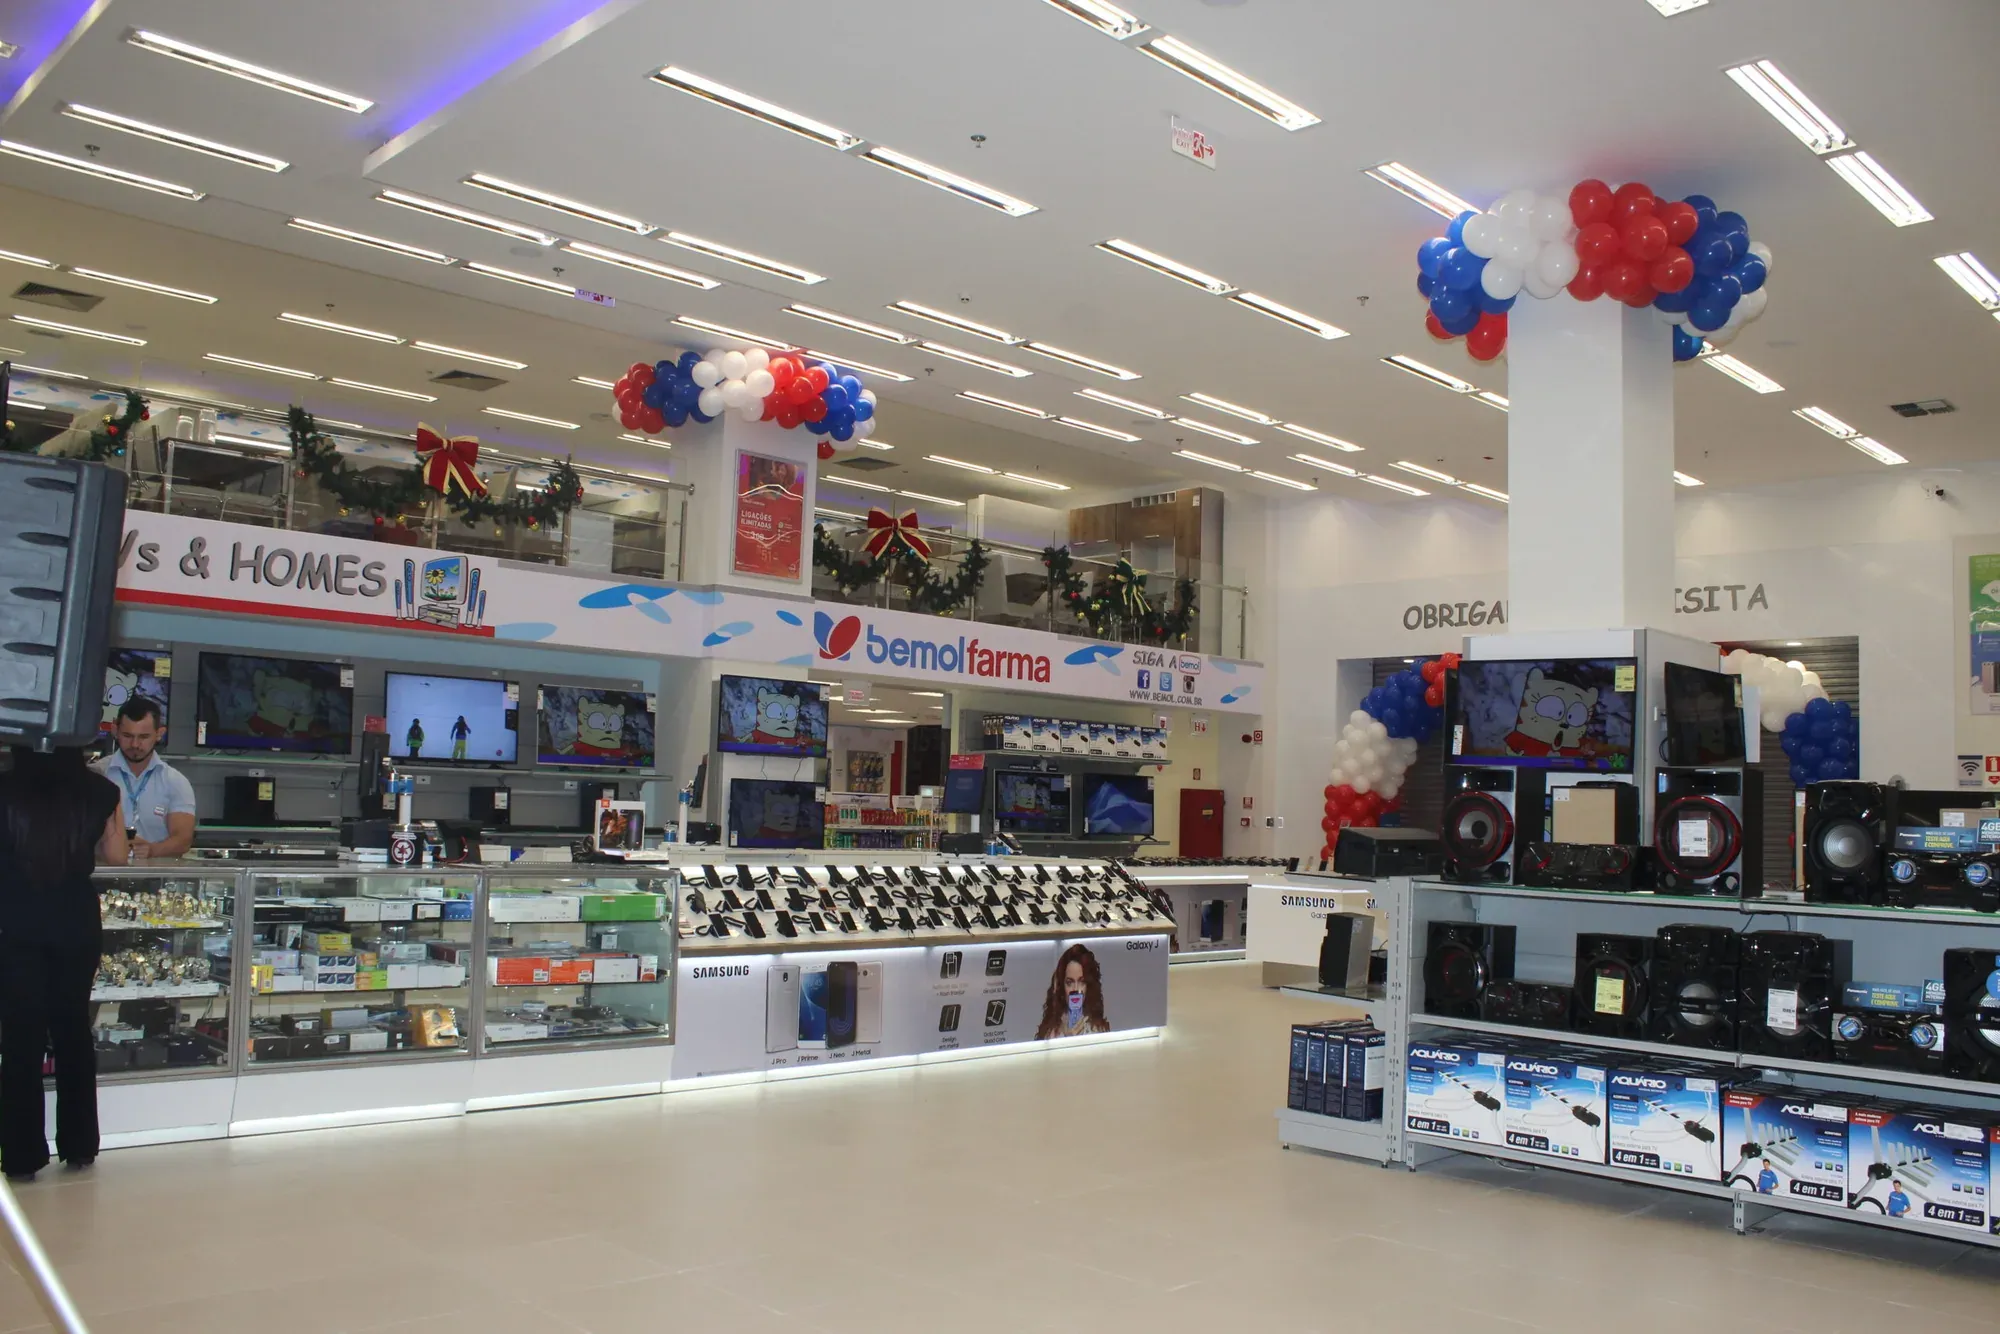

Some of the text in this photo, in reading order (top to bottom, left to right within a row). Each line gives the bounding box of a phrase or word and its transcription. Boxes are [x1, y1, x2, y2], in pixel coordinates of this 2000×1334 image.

[741, 510, 772, 521] LIGAÇÕES
[741, 519, 772, 530] ILIMITADAS
[180, 536, 211, 579] &
[230, 541, 387, 597] HOMES
[1402, 600, 1509, 631] OBRIGA
[1133, 651, 1199, 670] SIGA A bemol
[1129, 690, 1203, 706] WWW.BEMOL.COM.BR
[1281, 895, 1335, 909] SAMSUNG
[1126, 939, 1159, 952] Galaxy J
[693, 965, 750, 979] SAMSUNG
[776, 1057, 787, 1065] Pro
[801, 1054, 819, 1062] Prime
[833, 1051, 846, 1059] Neo
[1410, 1048, 1460, 1062] AQUÁRIO
[1507, 1061, 1558, 1075] AQUÁRIO
[1611, 1075, 1667, 1089] AQUÁRIO
[1410, 1118, 1436, 1130] 4 em 1
[1509, 1133, 1535, 1145] 4 em 1
[1615, 1151, 1644, 1164] 4 em 1
[1793, 1182, 1800, 1192] 4
[1802, 1185, 1817, 1194] em
[1820, 1186, 1825, 1197] 1
[1928, 1205, 1935, 1215] 4
[1937, 1209, 1954, 1219] em
[1958, 1210, 1964, 1221] 1
